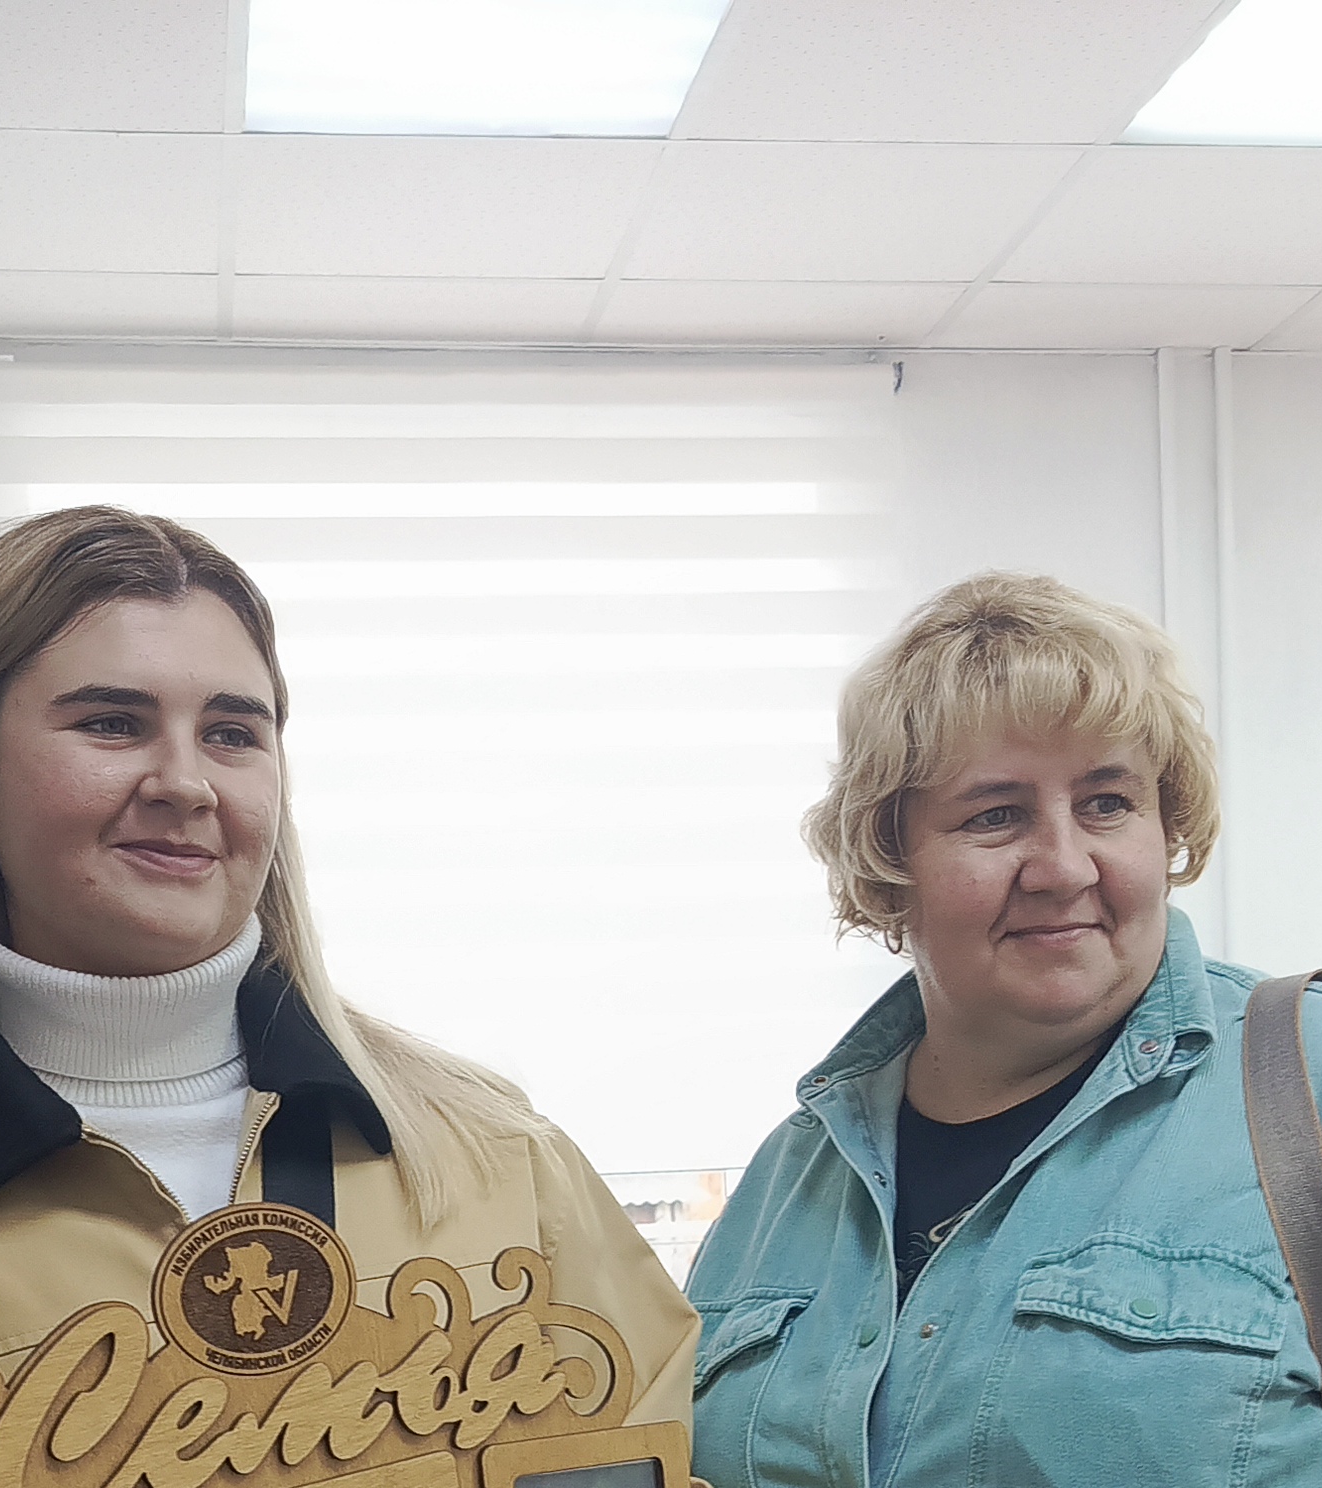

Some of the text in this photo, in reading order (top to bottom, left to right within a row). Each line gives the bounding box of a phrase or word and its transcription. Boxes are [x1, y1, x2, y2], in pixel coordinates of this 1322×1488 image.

[171, 1212, 329, 1277] ИЗБИРАТЕЛЬНАЯ КОМИССИЯ
[288, 1322, 333, 1363] ОБЛАСТИ
